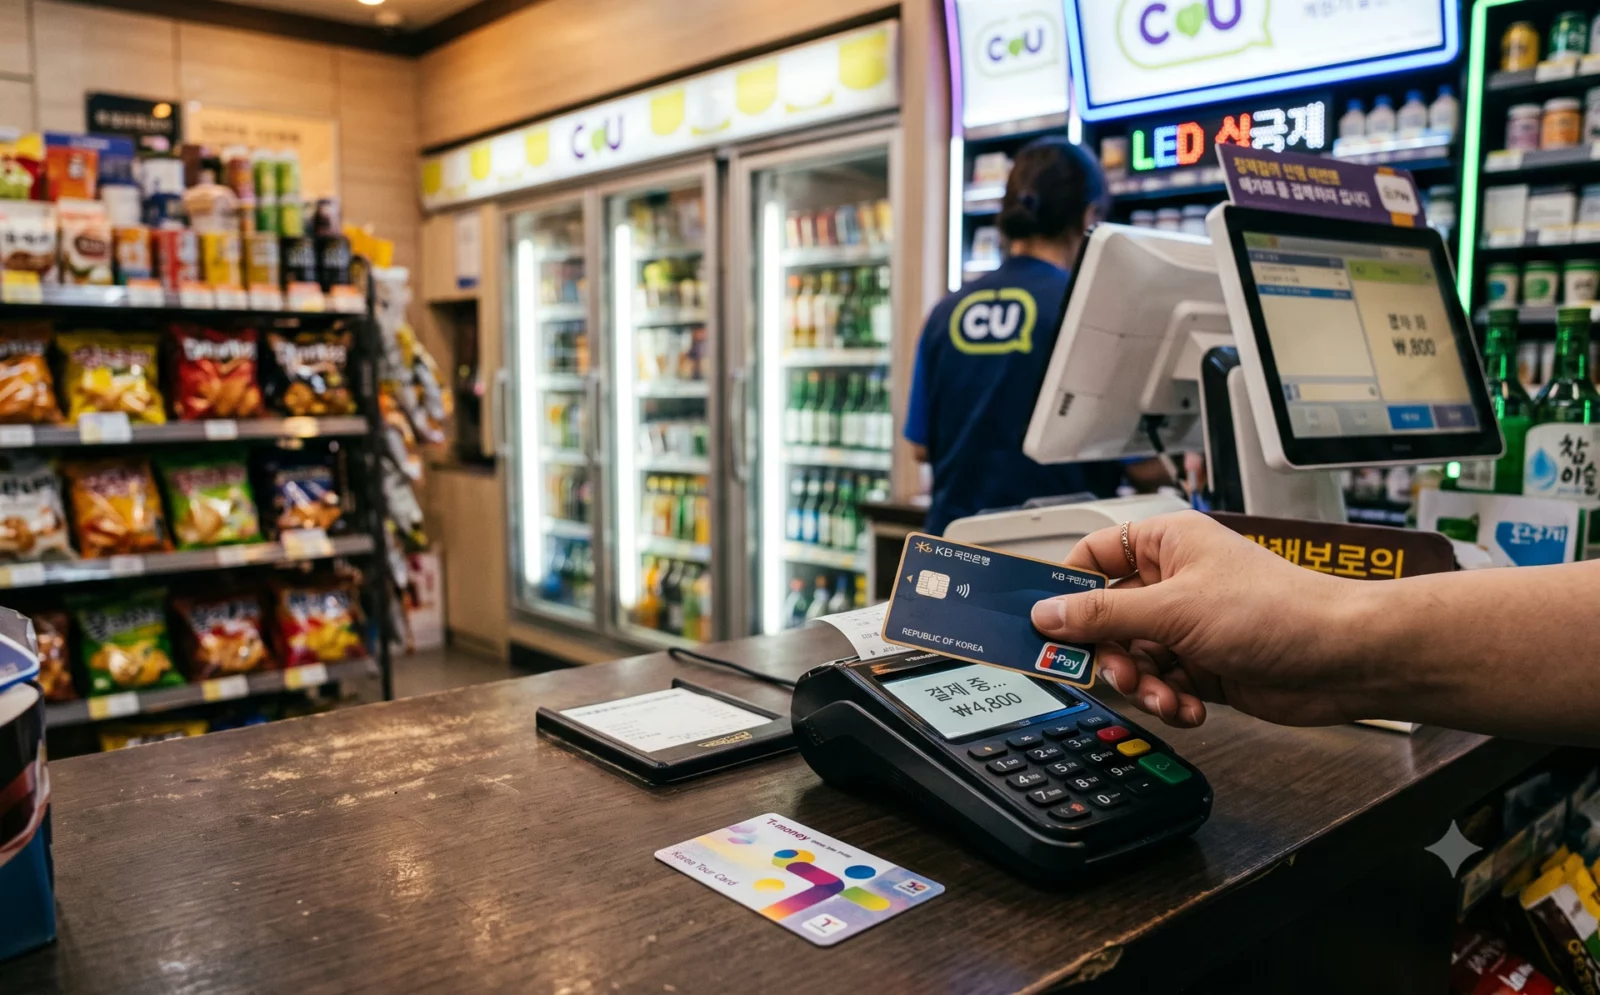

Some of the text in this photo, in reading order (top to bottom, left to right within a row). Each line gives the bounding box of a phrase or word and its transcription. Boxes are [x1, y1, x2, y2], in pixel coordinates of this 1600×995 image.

[1132, 121, 1205, 171] LED
[962, 302, 1021, 340] CU
[935, 546, 953, 558] KB
[1051, 571, 1065, 581] KB
[901, 627, 984, 653] REPUBLIC OF KOREA
[924, 682, 970, 702] 결제
[949, 692, 1023, 718] ₩4,800
[1068, 739, 1082, 748] 3
[1034, 749, 1047, 758] 2
[1090, 753, 1103, 762] 6
[997, 760, 1007, 769] 1
[1054, 763, 1068, 772] 5
[1110, 767, 1124, 776] 9
[1019, 775, 1030, 784] 4
[1075, 778, 1090, 788] 8
[1034, 790, 1047, 800] 7
[1096, 794, 1111, 804] 0
[672, 851, 739, 886] Korea Tour Card
